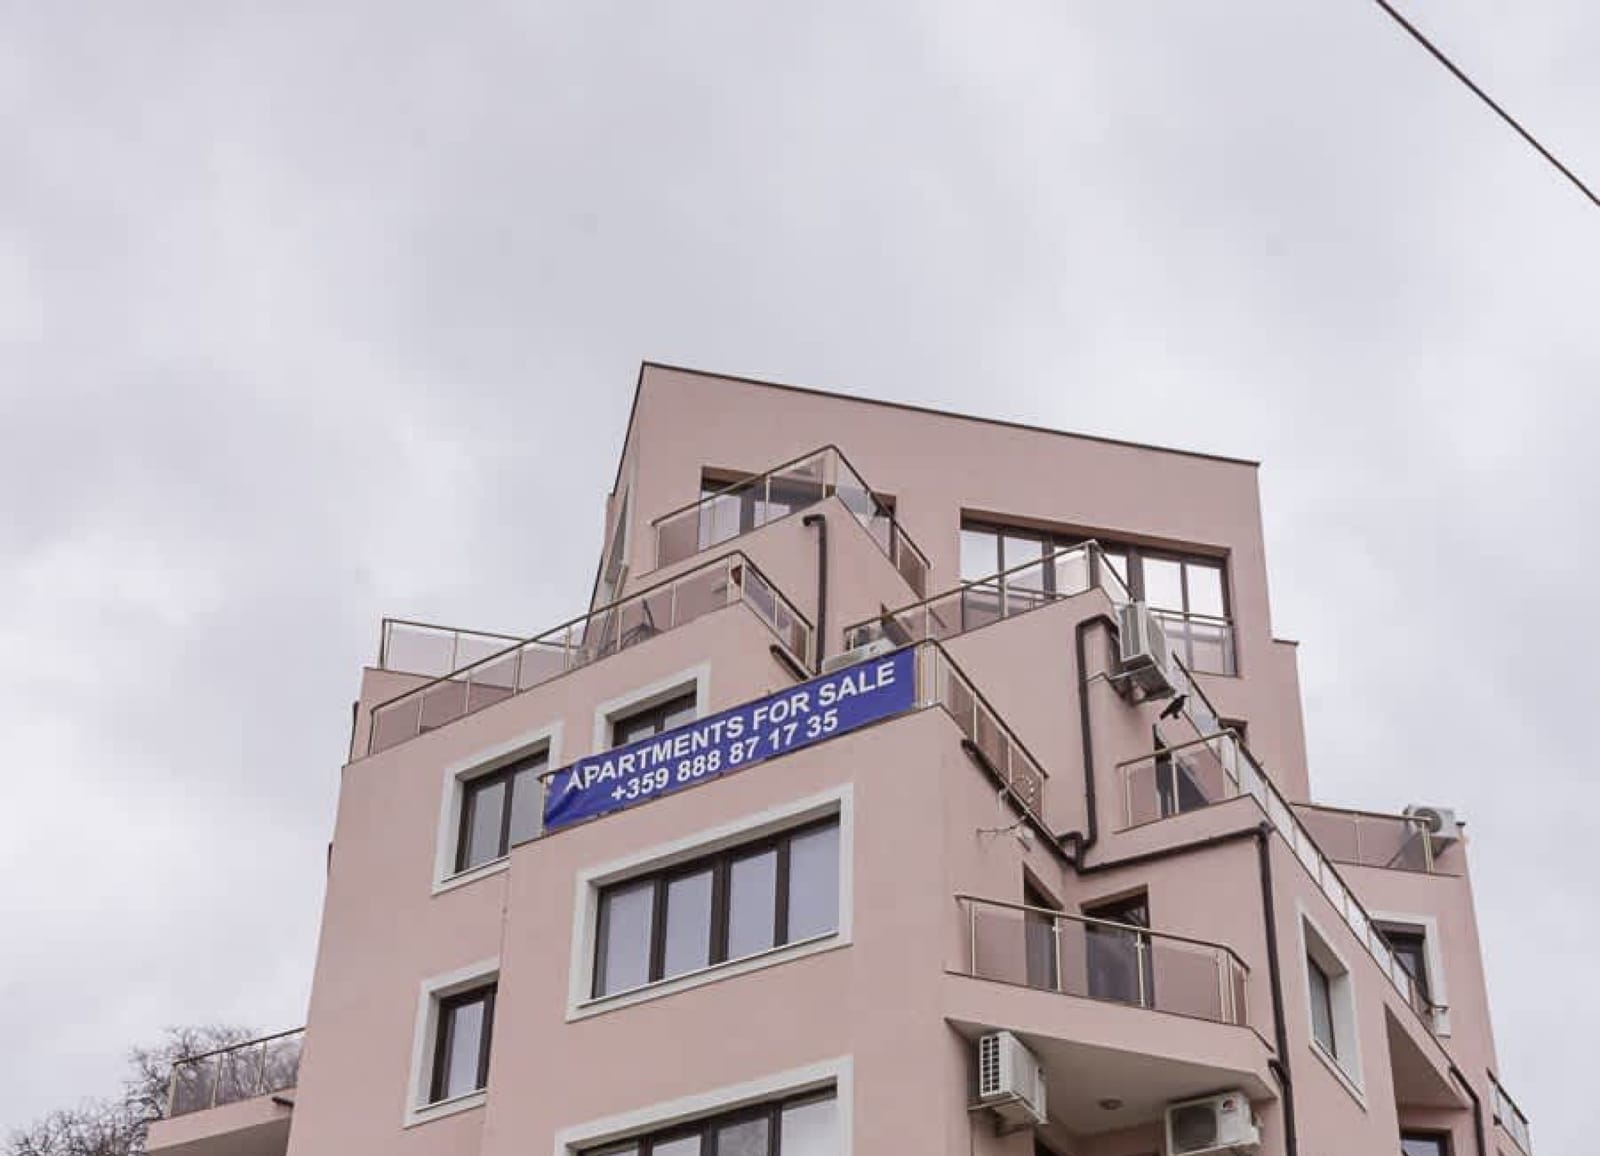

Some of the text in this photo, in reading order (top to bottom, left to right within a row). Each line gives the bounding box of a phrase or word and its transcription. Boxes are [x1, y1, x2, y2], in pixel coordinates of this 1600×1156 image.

[566, 661, 895, 793] APARTMENTS FOR SALE
[611, 709, 838, 801] +359 888 87 17 35
